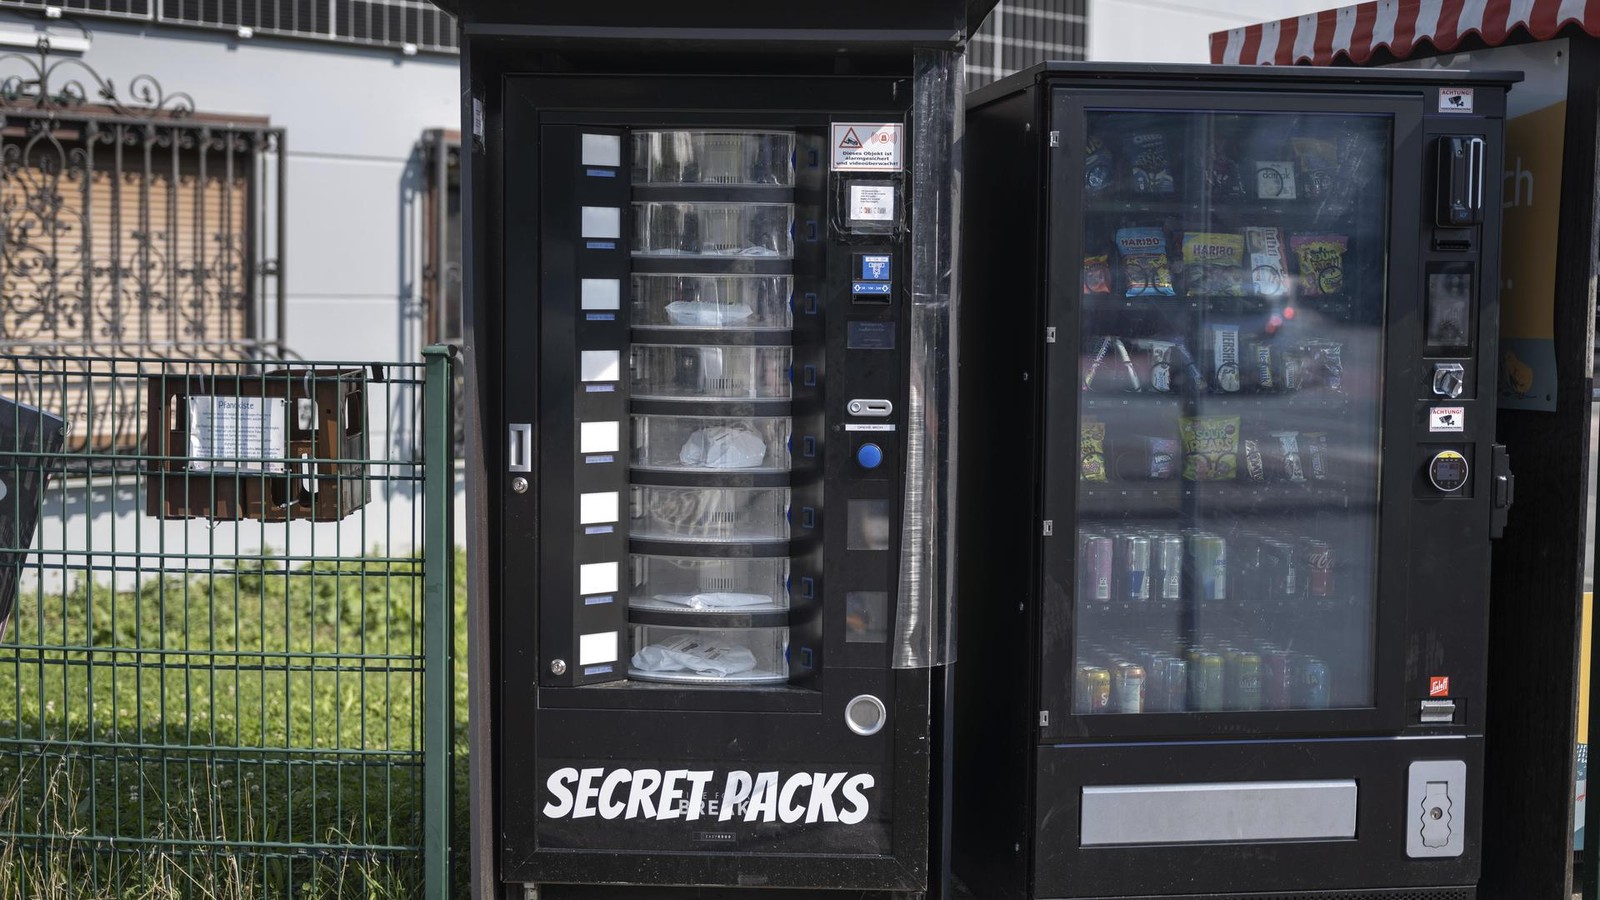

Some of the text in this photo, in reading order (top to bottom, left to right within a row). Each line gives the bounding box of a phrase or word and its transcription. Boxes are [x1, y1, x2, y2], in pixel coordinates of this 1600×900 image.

[1121, 238, 1160, 247] HARIBO
[1193, 244, 1233, 256] HARIBO
[1195, 428, 1226, 440] SOUR
[542, 767, 875, 825] SECRET PACKS
[678, 800, 750, 816] BREK
